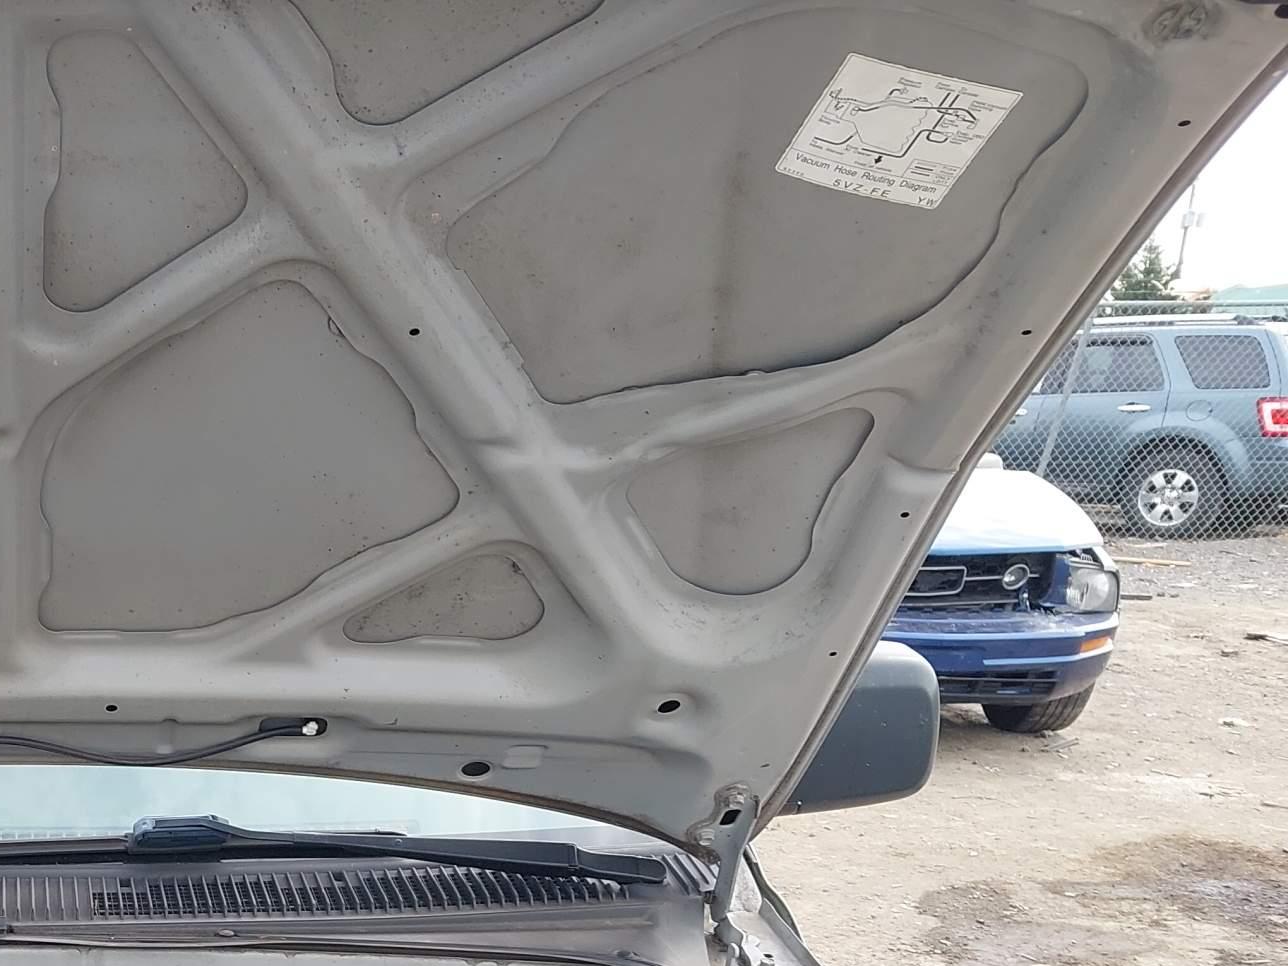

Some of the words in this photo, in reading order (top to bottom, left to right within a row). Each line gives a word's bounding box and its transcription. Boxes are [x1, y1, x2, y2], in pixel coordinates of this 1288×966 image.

[795, 152, 831, 170] Vacuum
[834, 164, 858, 177] Hose
[861, 171, 896, 187] Routing
[899, 179, 937, 194] Diagram
